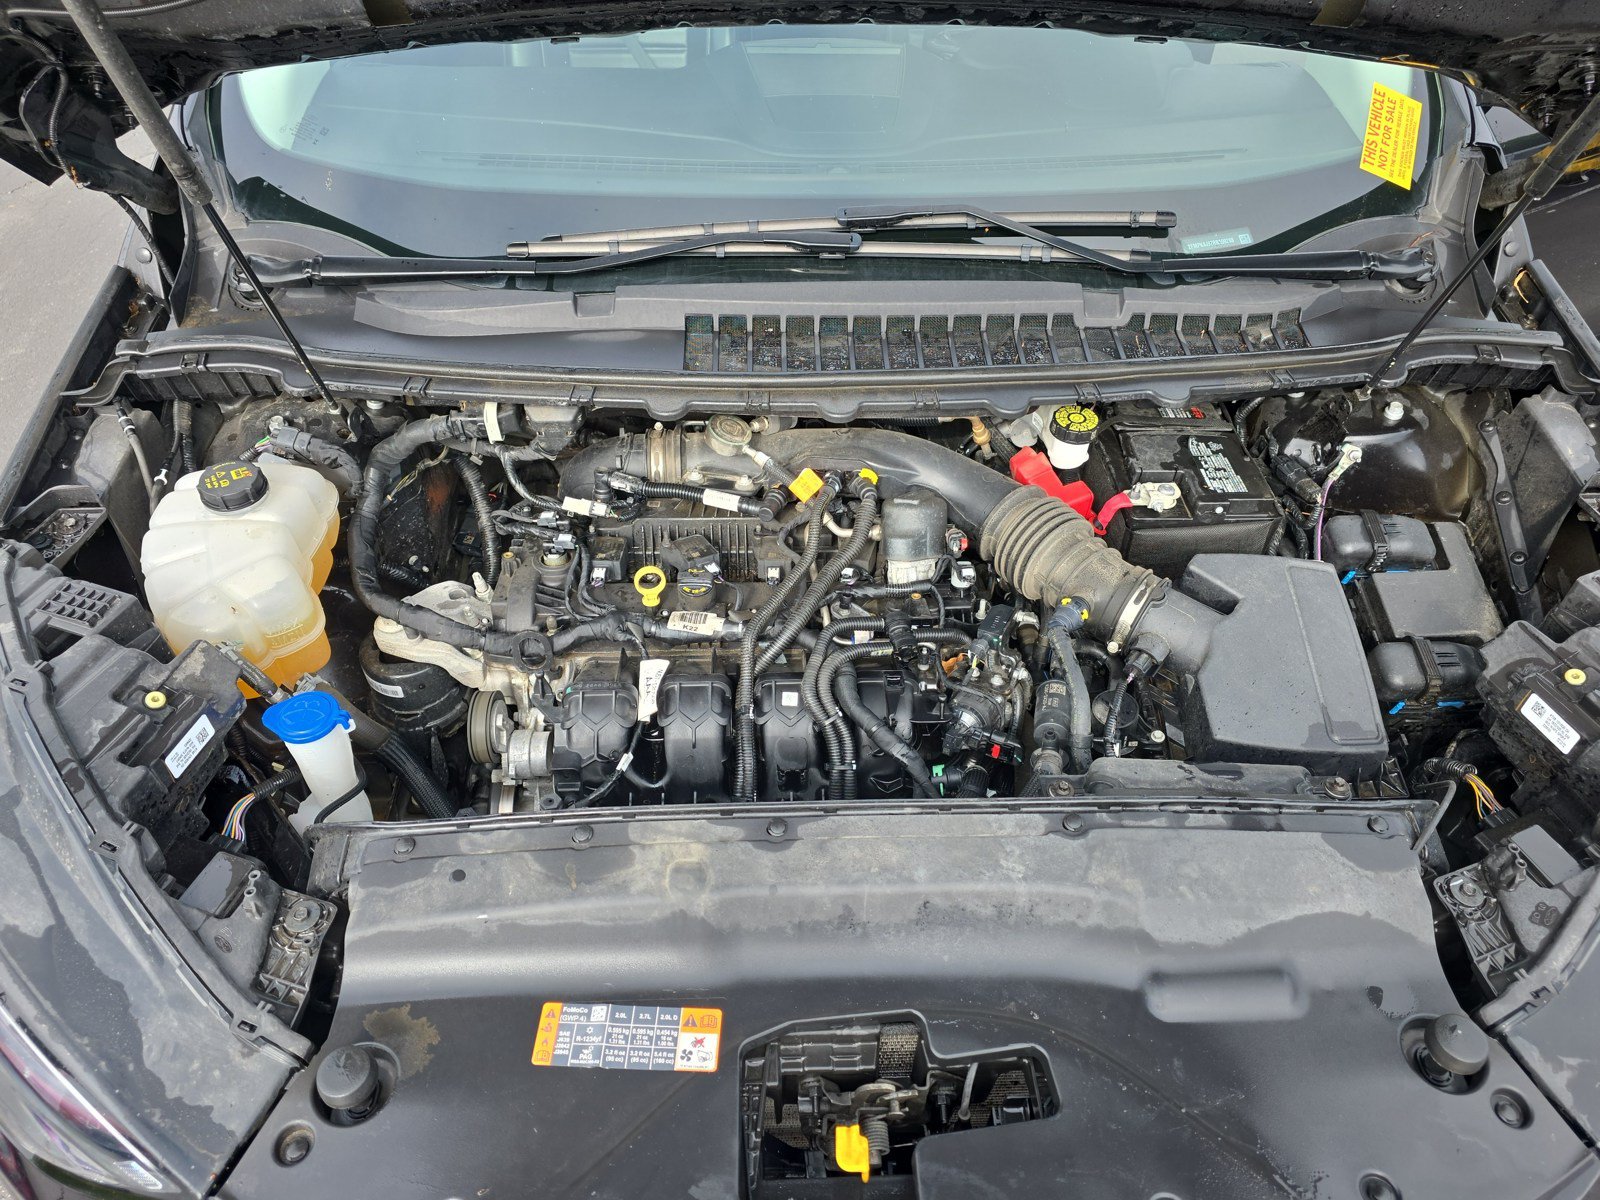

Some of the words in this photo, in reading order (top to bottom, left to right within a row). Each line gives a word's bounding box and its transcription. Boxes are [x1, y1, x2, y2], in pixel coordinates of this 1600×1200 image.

[1367, 87, 1386, 138] VEHICLE
[1384, 96, 1396, 123] SALE
[1381, 124, 1392, 147] FOR
[1362, 137, 1377, 167] THIS
[1376, 147, 1388, 170] NOT
